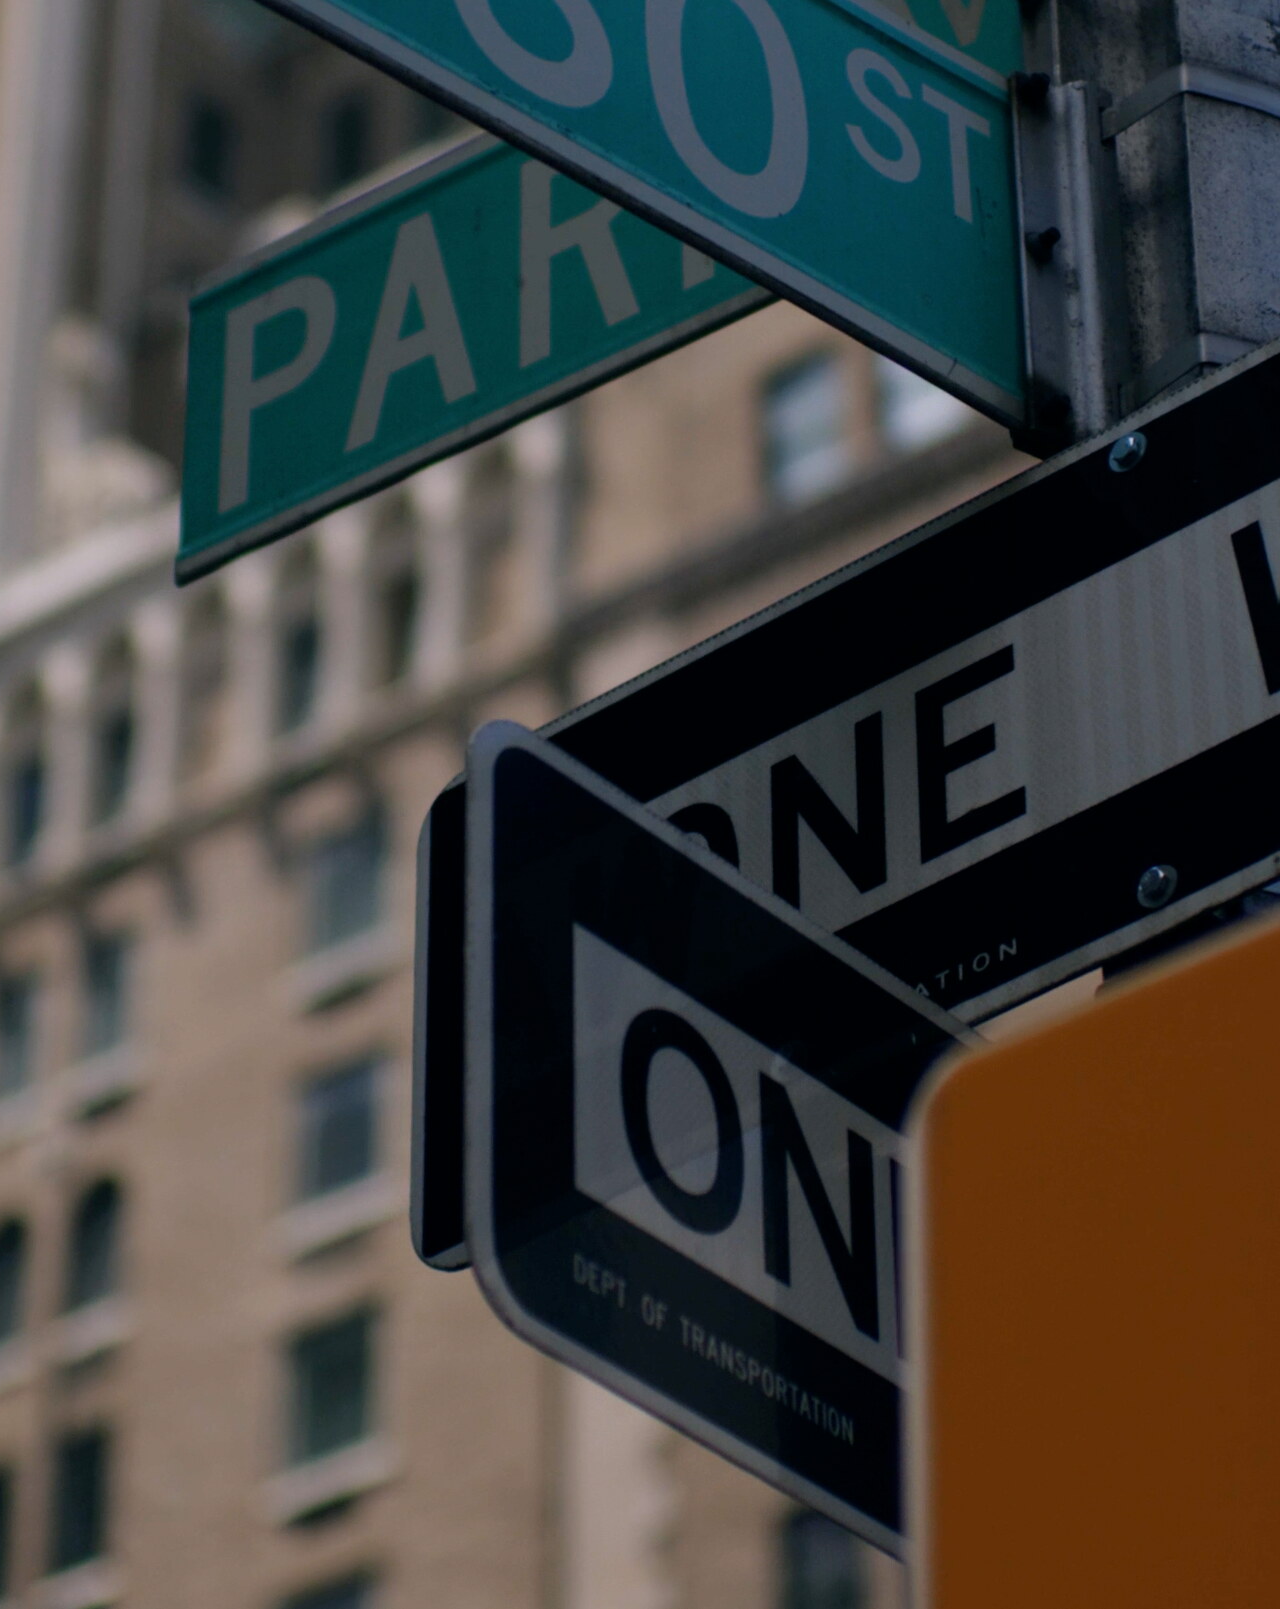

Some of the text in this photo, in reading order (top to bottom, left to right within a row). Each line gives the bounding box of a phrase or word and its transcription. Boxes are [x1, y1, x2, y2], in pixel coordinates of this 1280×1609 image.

[844, 47, 992, 225] ST
[218, 153, 716, 516] PAR
[620, 1008, 902, 1358] ON
[641, 1294, 668, 1330] OF
[679, 1315, 855, 1446] TRANSPORTATION
